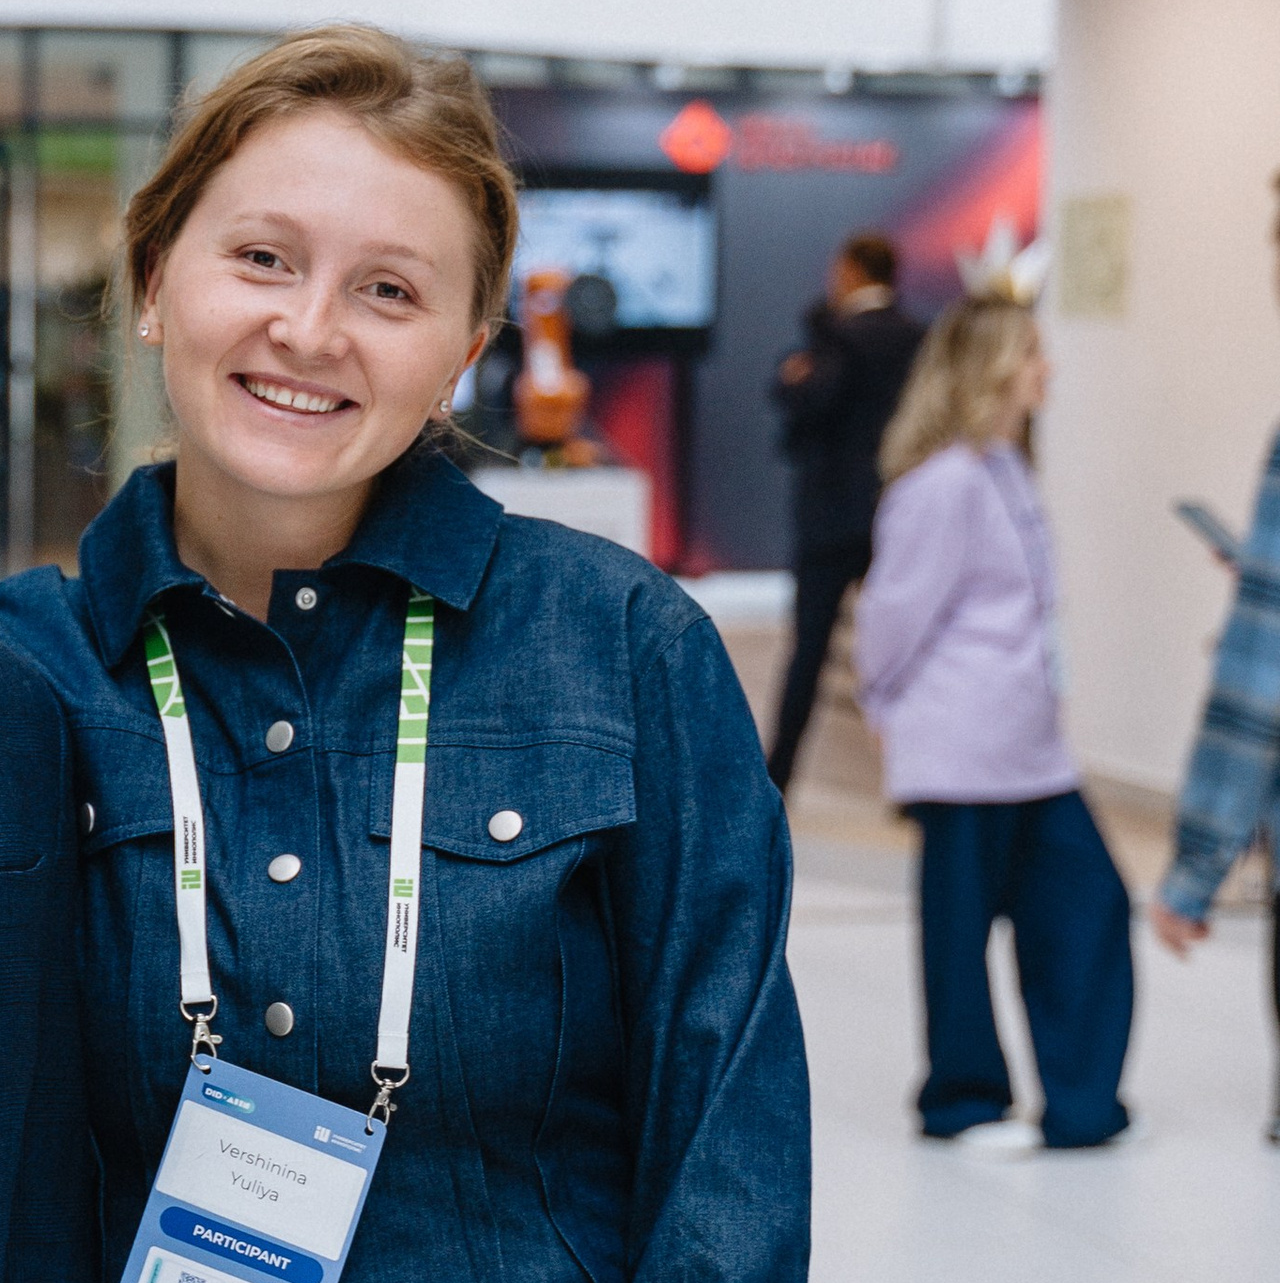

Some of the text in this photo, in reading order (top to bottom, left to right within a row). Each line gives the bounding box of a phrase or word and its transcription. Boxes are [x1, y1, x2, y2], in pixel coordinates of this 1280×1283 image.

[219, 1138, 308, 1186] Vershinina
[231, 1171, 280, 1203] Yuliya
[192, 1224, 292, 1271] PARTICIPANT
